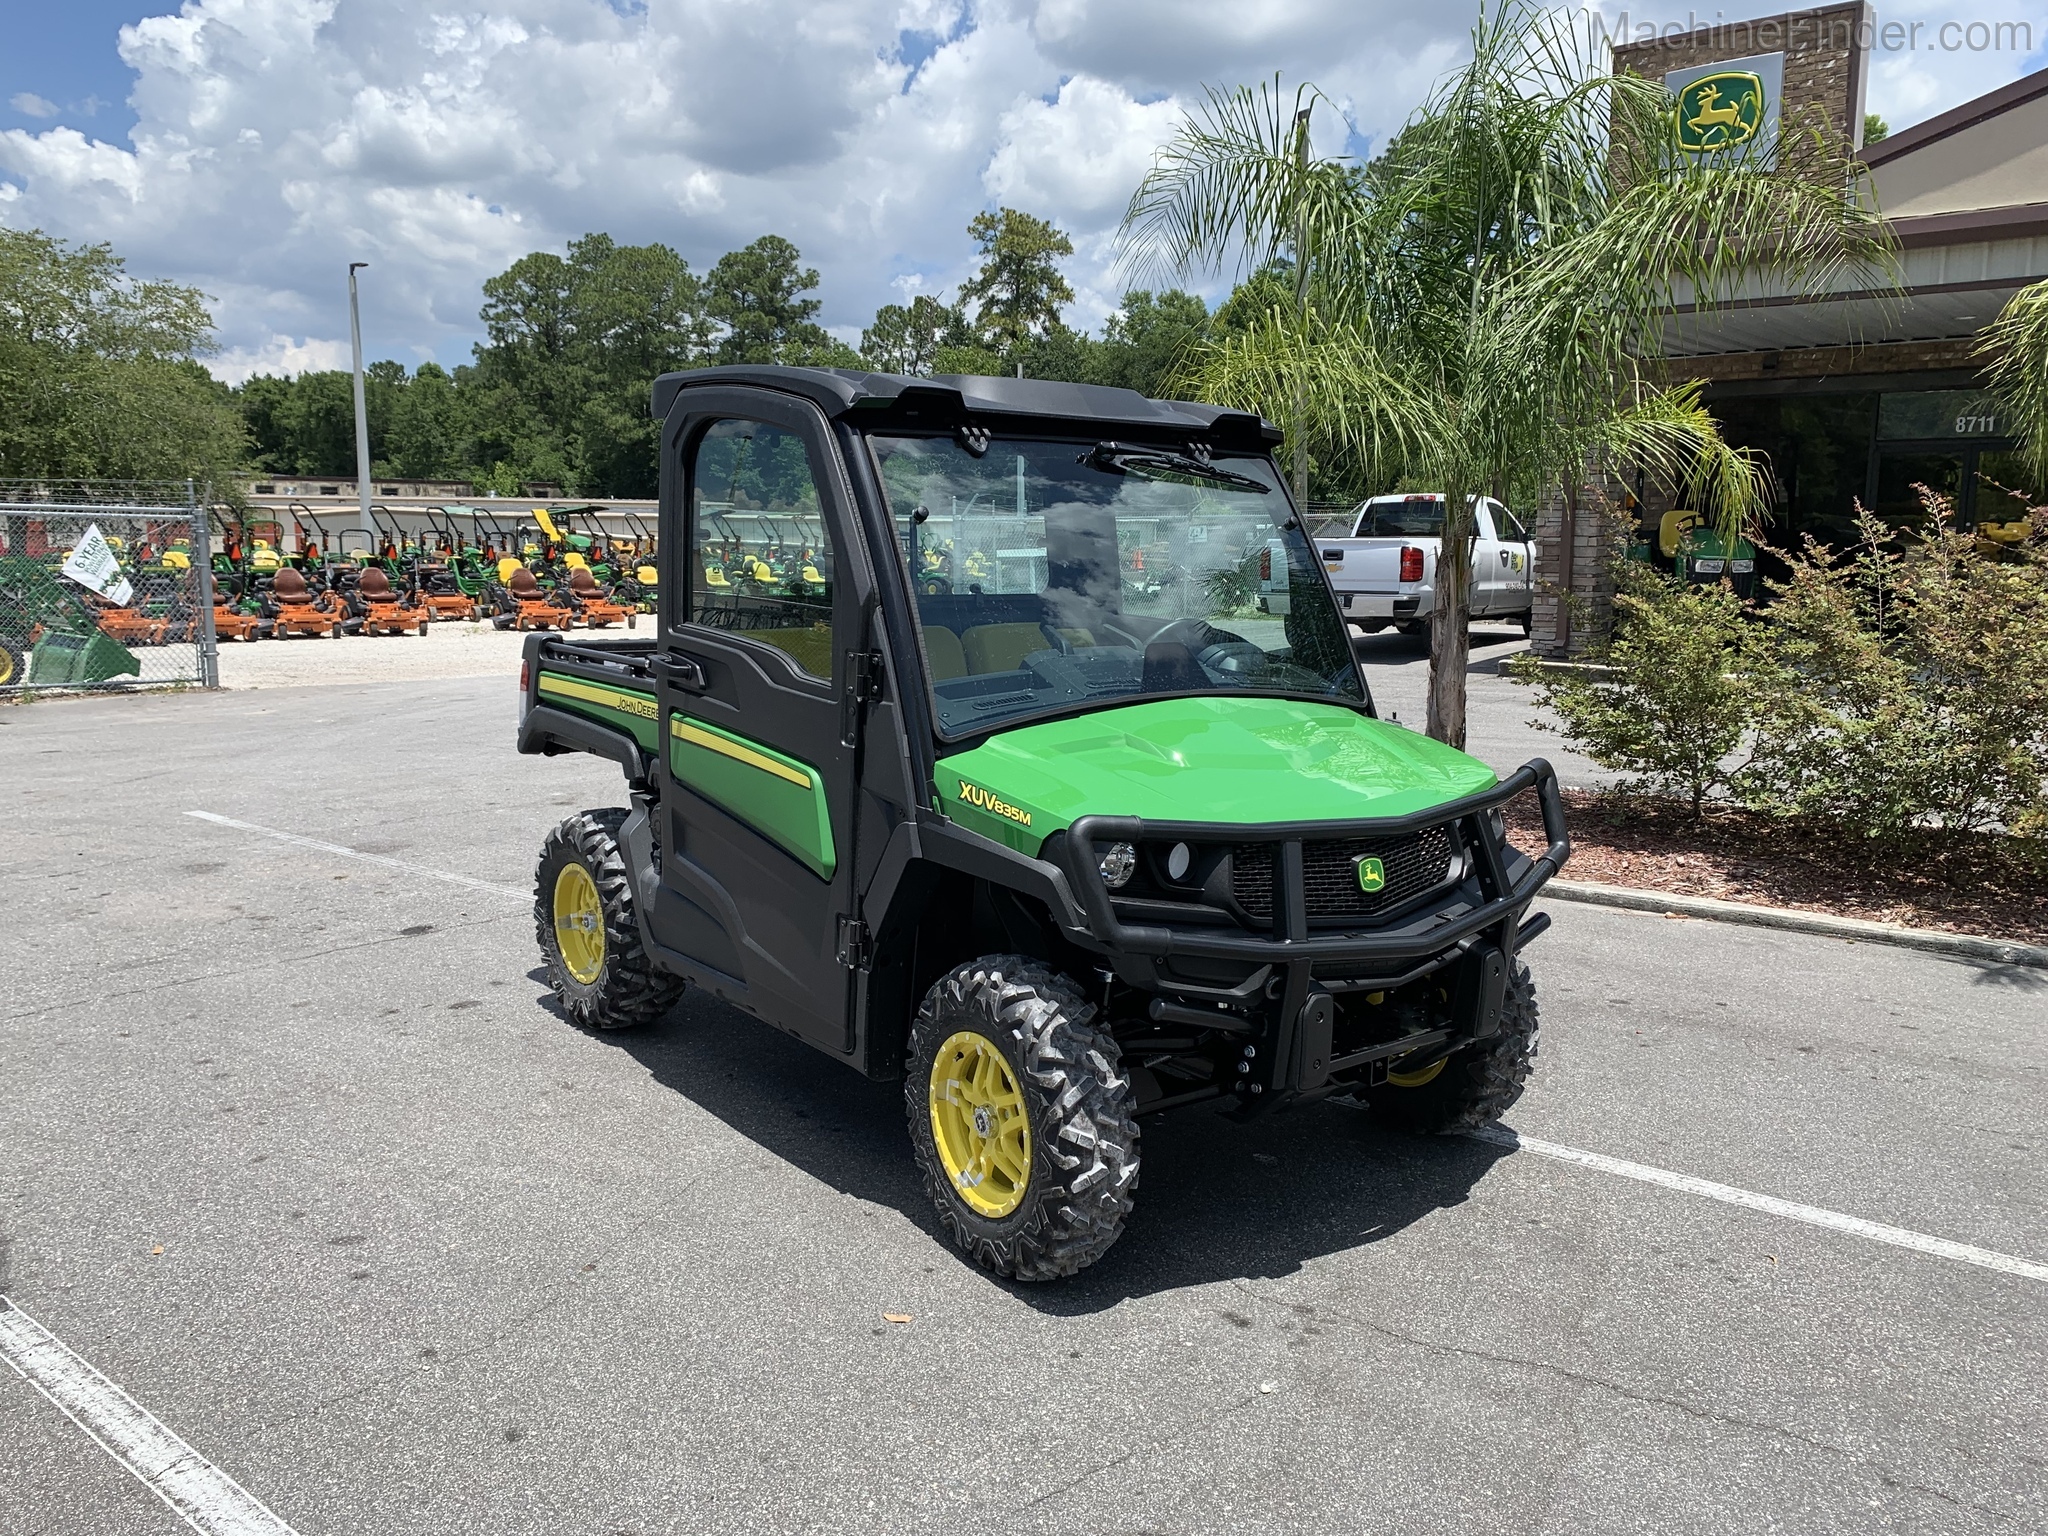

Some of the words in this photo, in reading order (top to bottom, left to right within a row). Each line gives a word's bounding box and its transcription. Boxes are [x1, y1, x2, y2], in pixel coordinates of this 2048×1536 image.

[1955, 415, 1995, 433] 8711
[74, 535, 103, 569] 6-YEAR
[89, 547, 111, 576] WARRANT
[616, 696, 637, 713] JOHN
[637, 701, 659, 719] DEERE
[958, 779, 1032, 828] XUV835M
